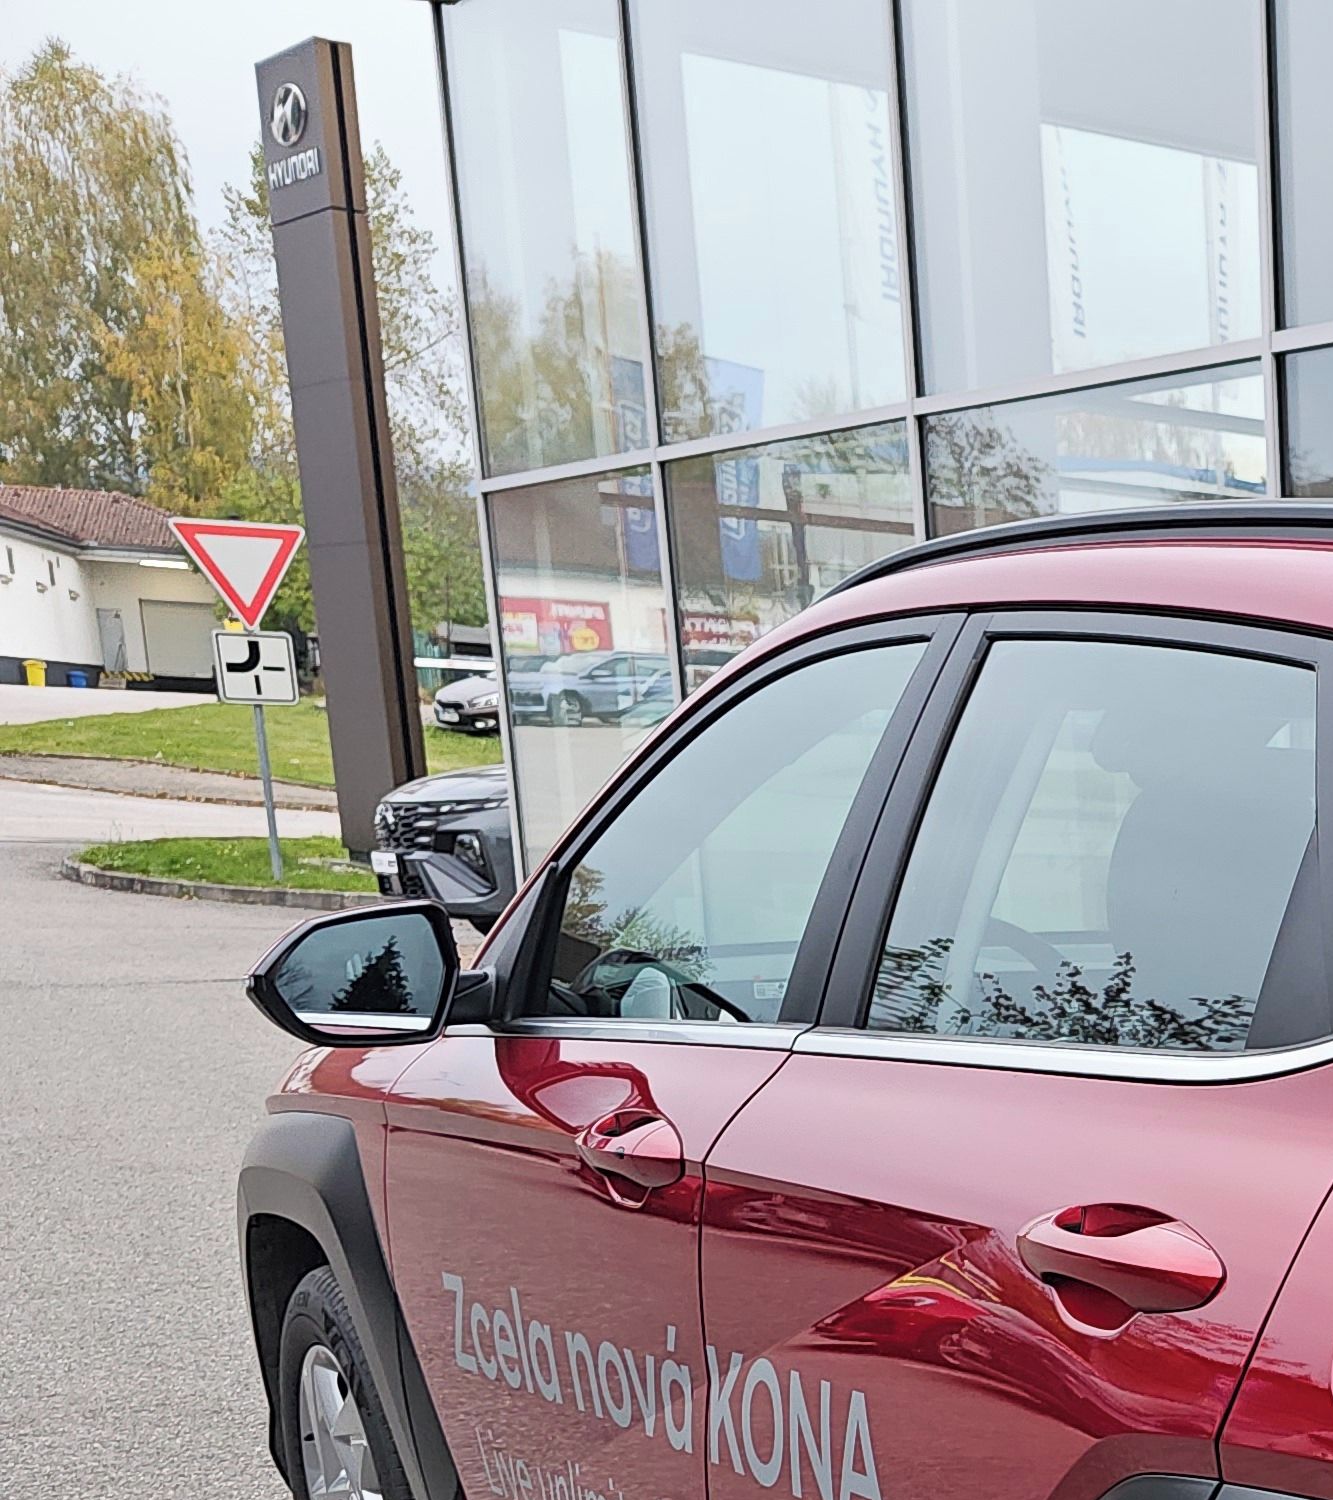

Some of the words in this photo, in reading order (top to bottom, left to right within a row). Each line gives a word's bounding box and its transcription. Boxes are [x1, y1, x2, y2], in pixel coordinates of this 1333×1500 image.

[267, 147, 320, 191] HYUNDAI
[441, 1271, 564, 1404] Zcela
[565, 1325, 694, 1454] nová
